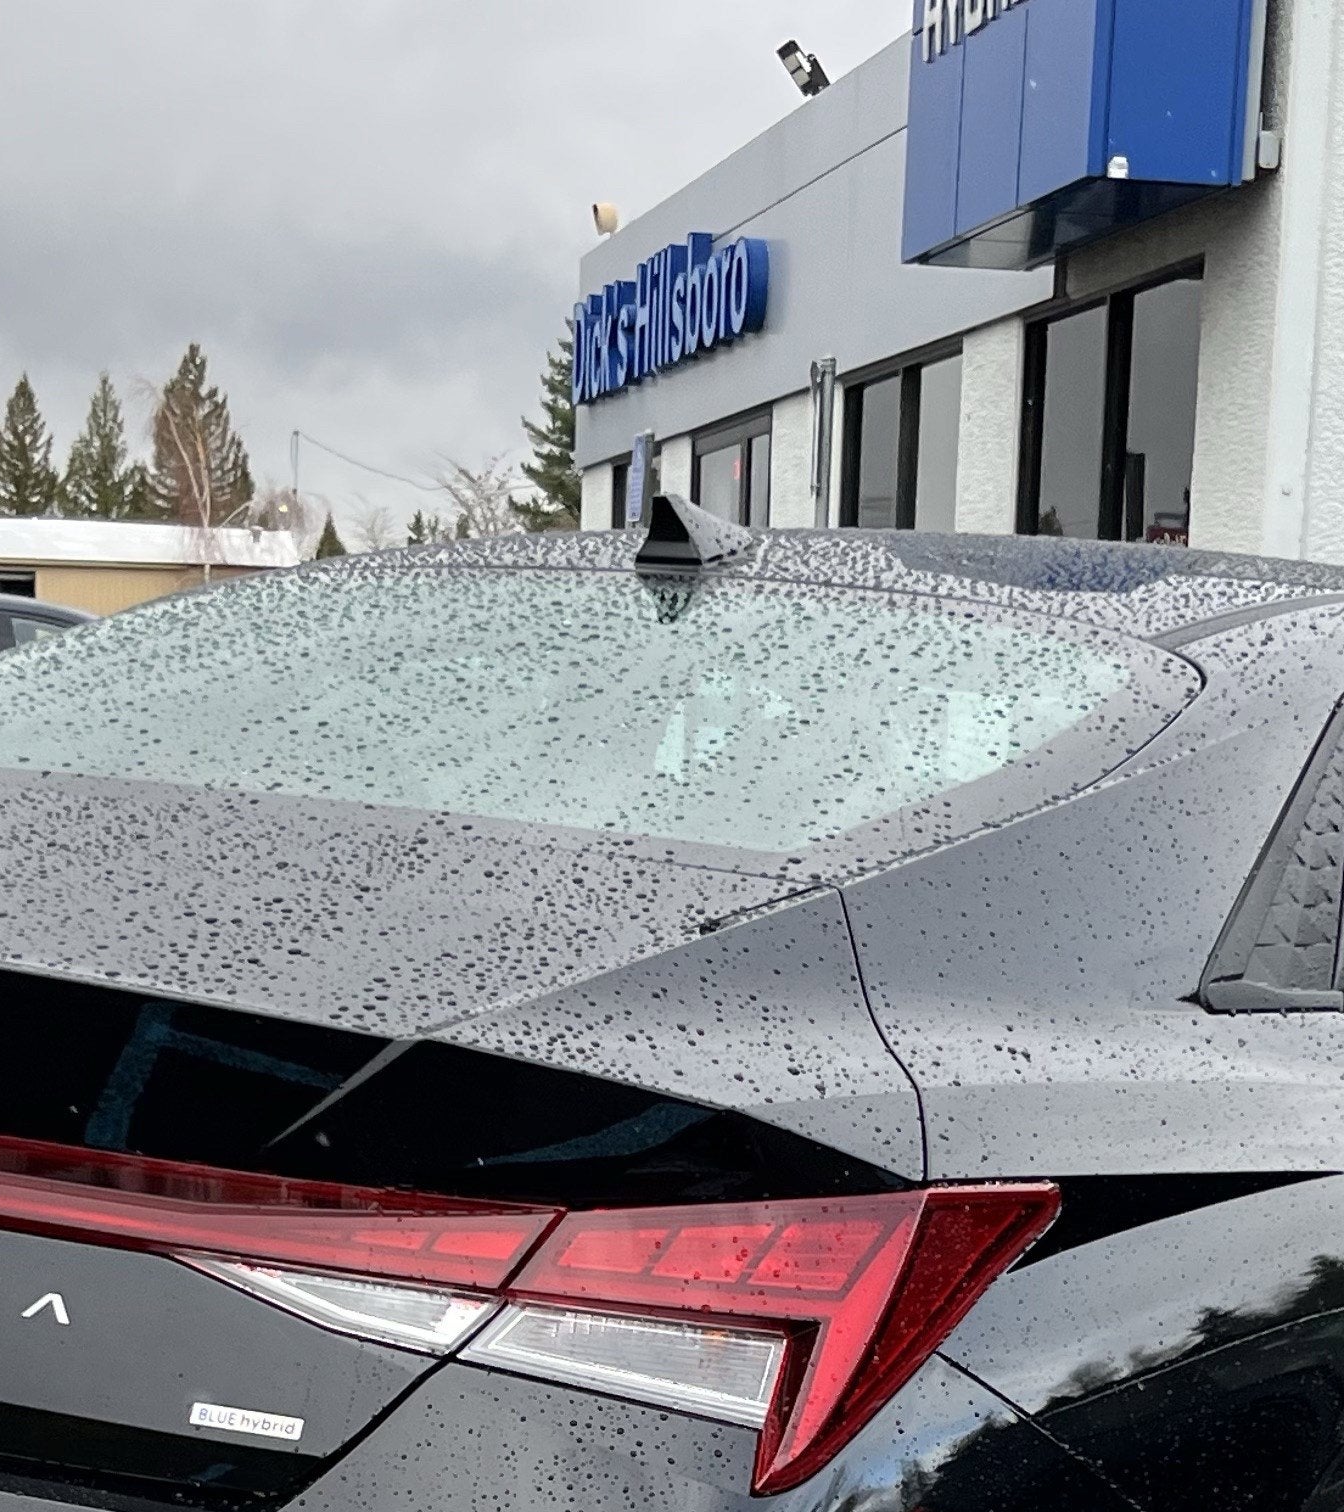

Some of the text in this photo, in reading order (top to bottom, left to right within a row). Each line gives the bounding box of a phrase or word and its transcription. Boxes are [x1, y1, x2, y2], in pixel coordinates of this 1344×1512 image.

[572, 232, 754, 405] Dick's Hillsboro
[198, 1407, 297, 1435] BLUE hybrid
